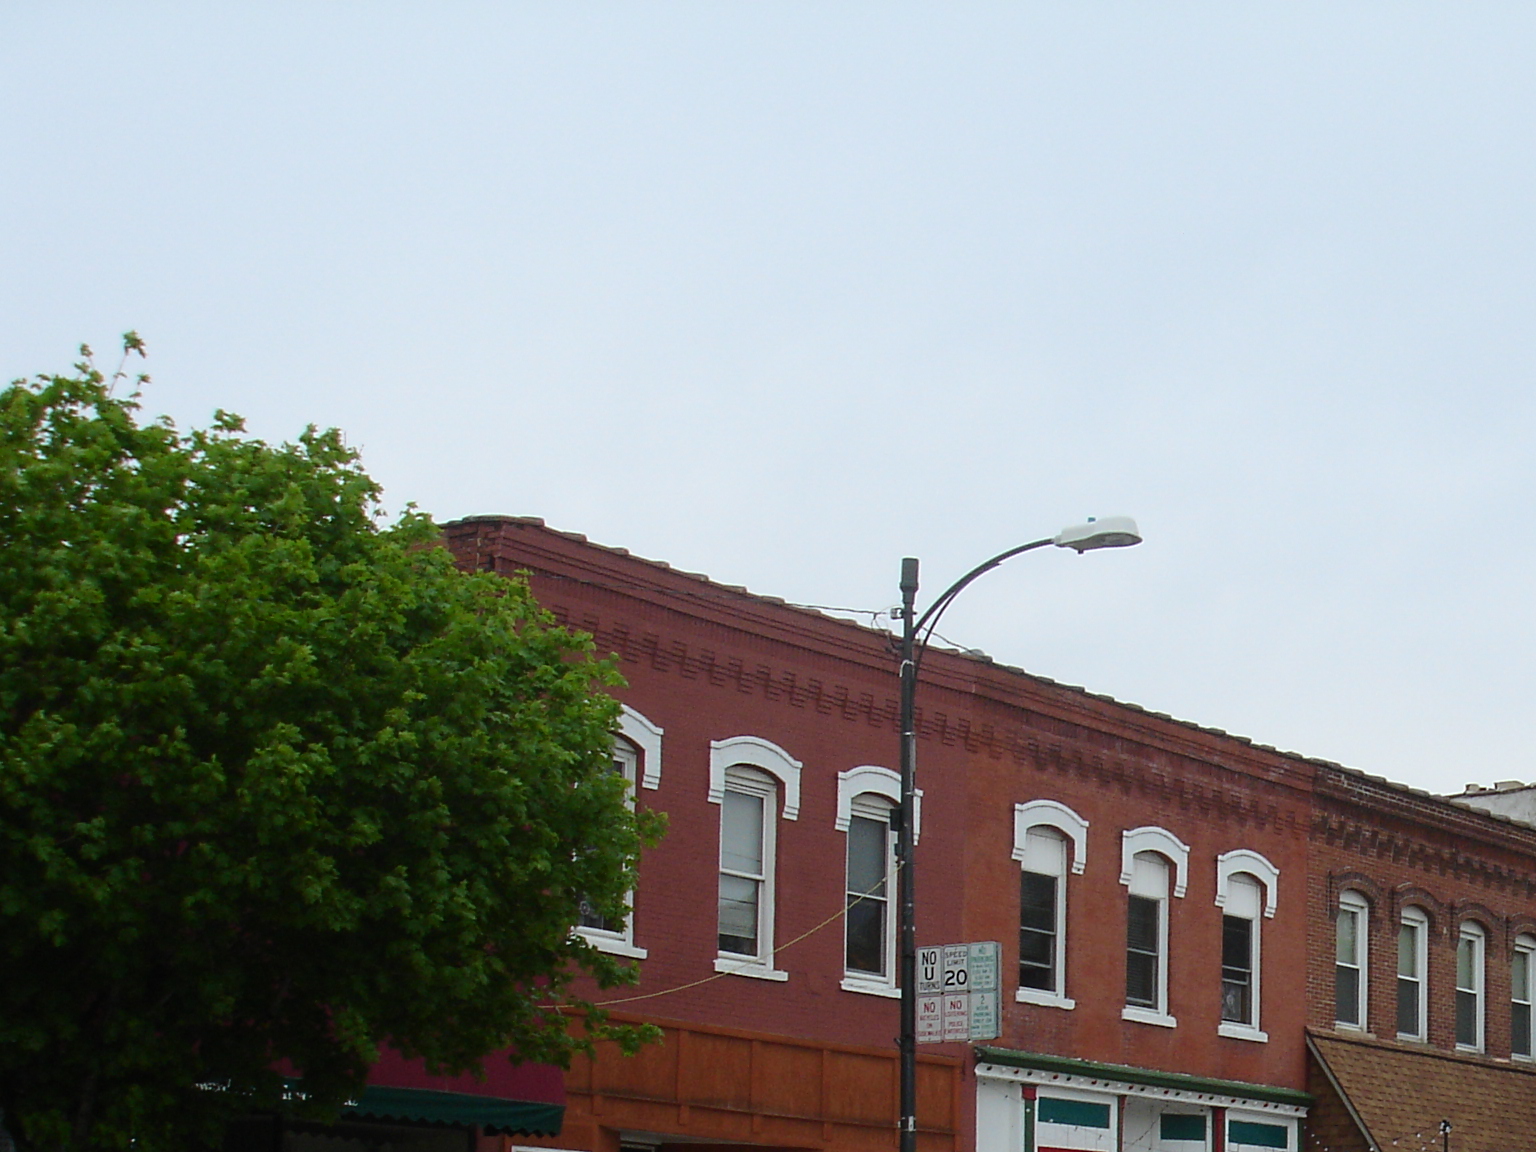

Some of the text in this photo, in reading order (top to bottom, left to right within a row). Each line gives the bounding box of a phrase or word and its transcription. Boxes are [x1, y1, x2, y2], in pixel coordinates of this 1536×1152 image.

[922, 951, 937, 966] NO
[945, 951, 968, 959] SPEED
[925, 967, 934, 980] U
[944, 969, 968, 986] 20
[919, 981, 940, 990] TURNS
[924, 1002, 935, 1013] NO
[950, 1000, 962, 1010] NO
